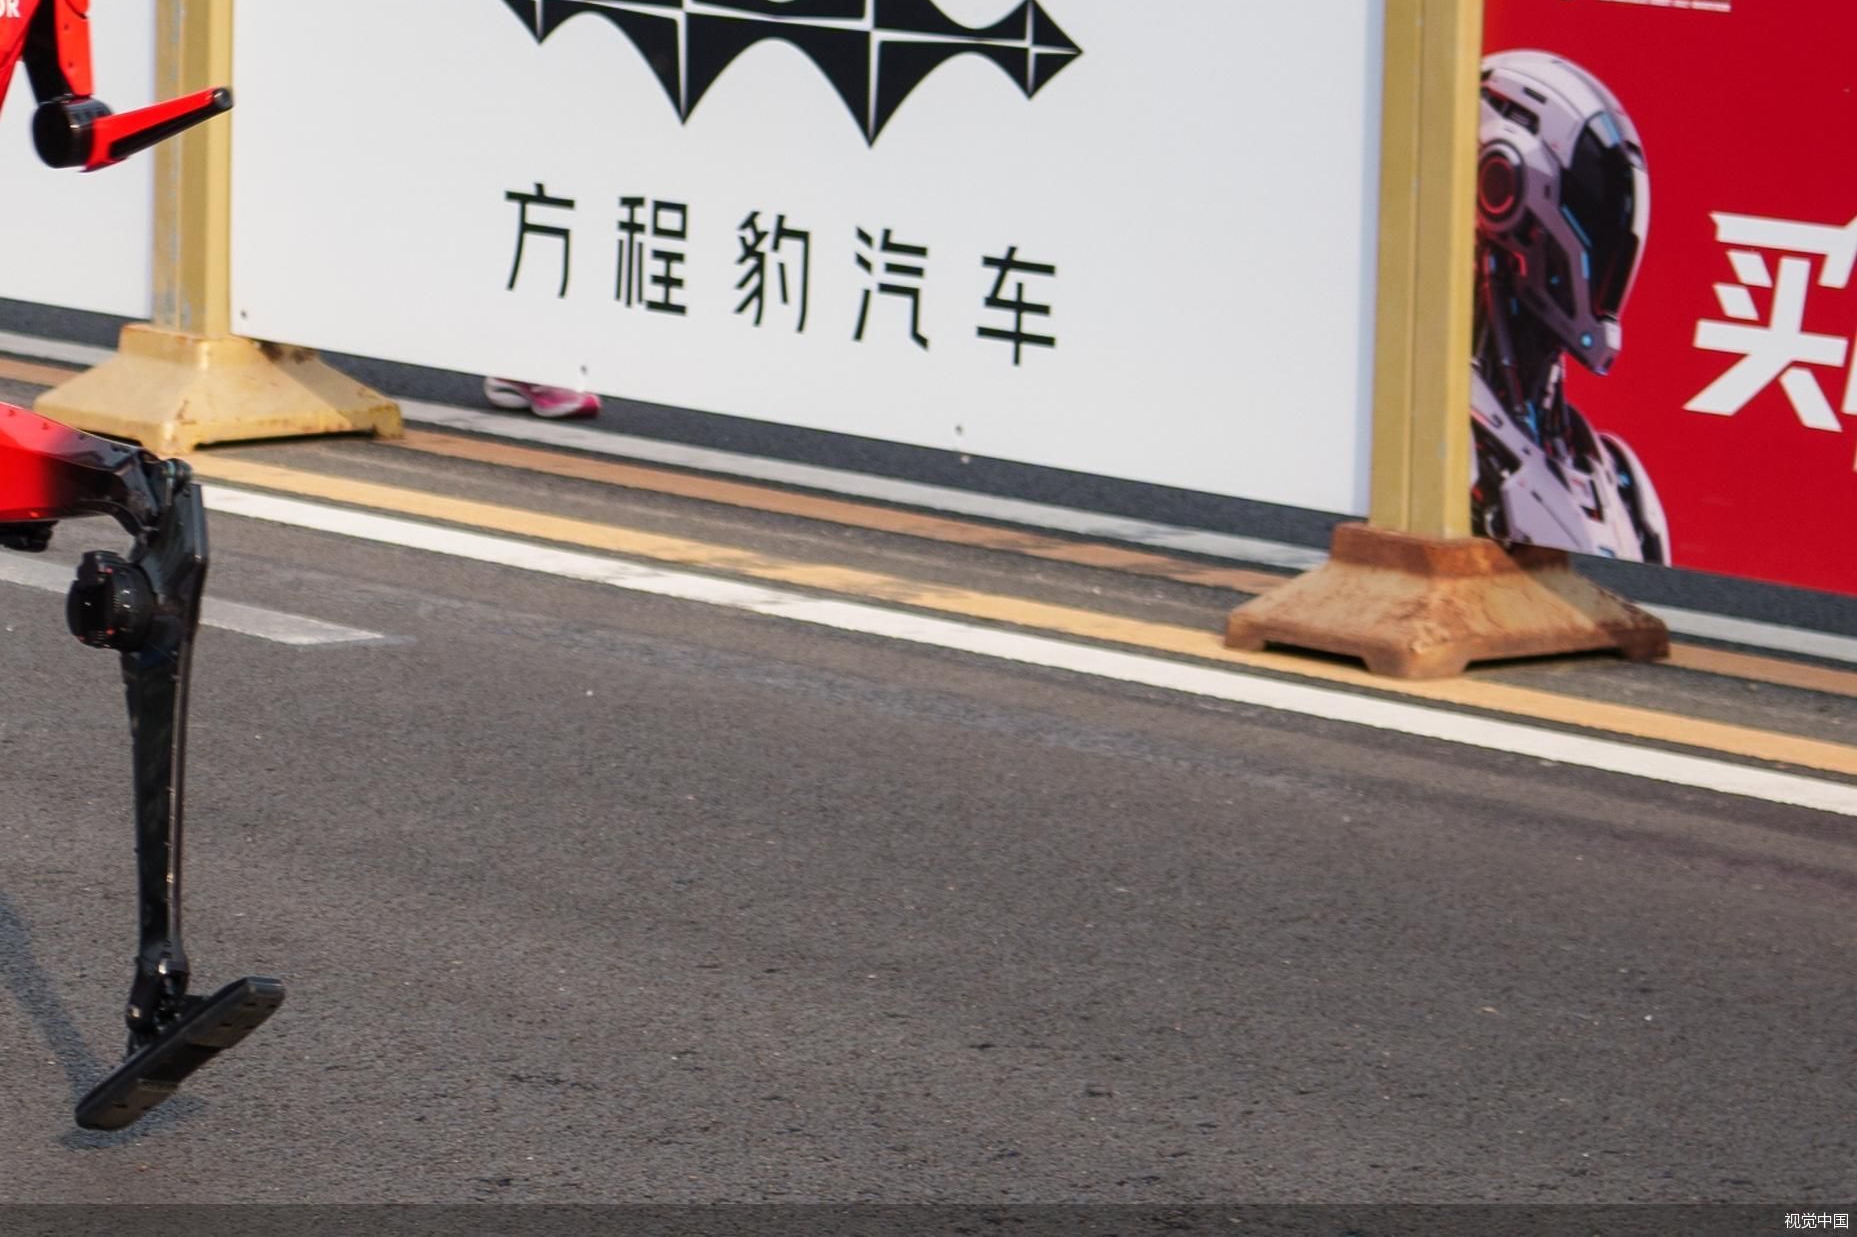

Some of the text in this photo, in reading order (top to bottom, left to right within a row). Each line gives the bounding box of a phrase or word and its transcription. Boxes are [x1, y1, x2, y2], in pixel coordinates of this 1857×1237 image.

[504, 182, 1056, 365] 方程豹汽车
[1682, 210, 1857, 473] 买
